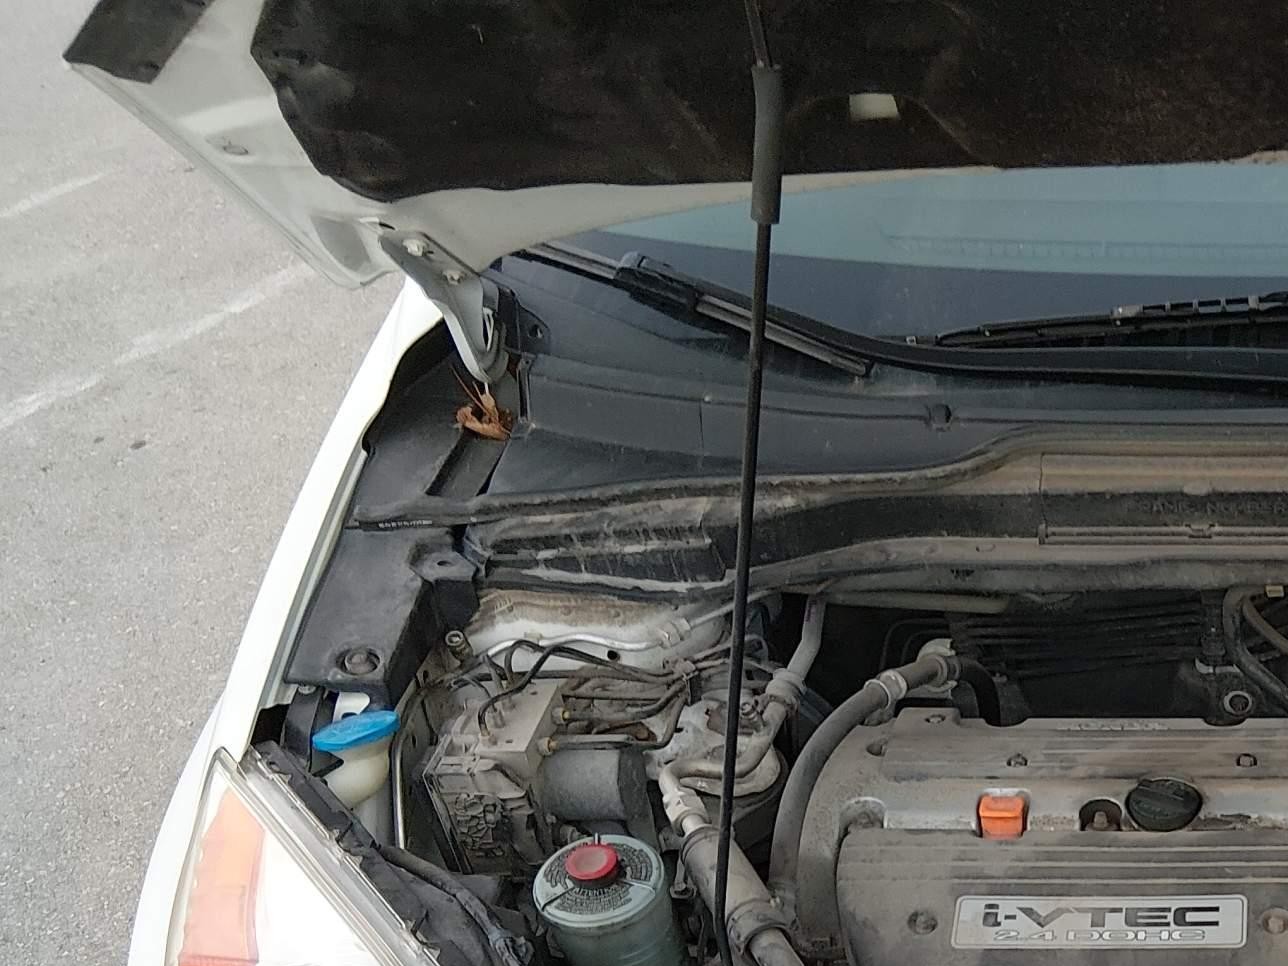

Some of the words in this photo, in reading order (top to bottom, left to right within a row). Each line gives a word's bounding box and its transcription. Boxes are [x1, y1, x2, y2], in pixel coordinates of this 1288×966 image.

[982, 903, 1220, 928] i-VTEC
[993, 929, 1057, 941] 2.4
[1066, 929, 1206, 941] DOHC
